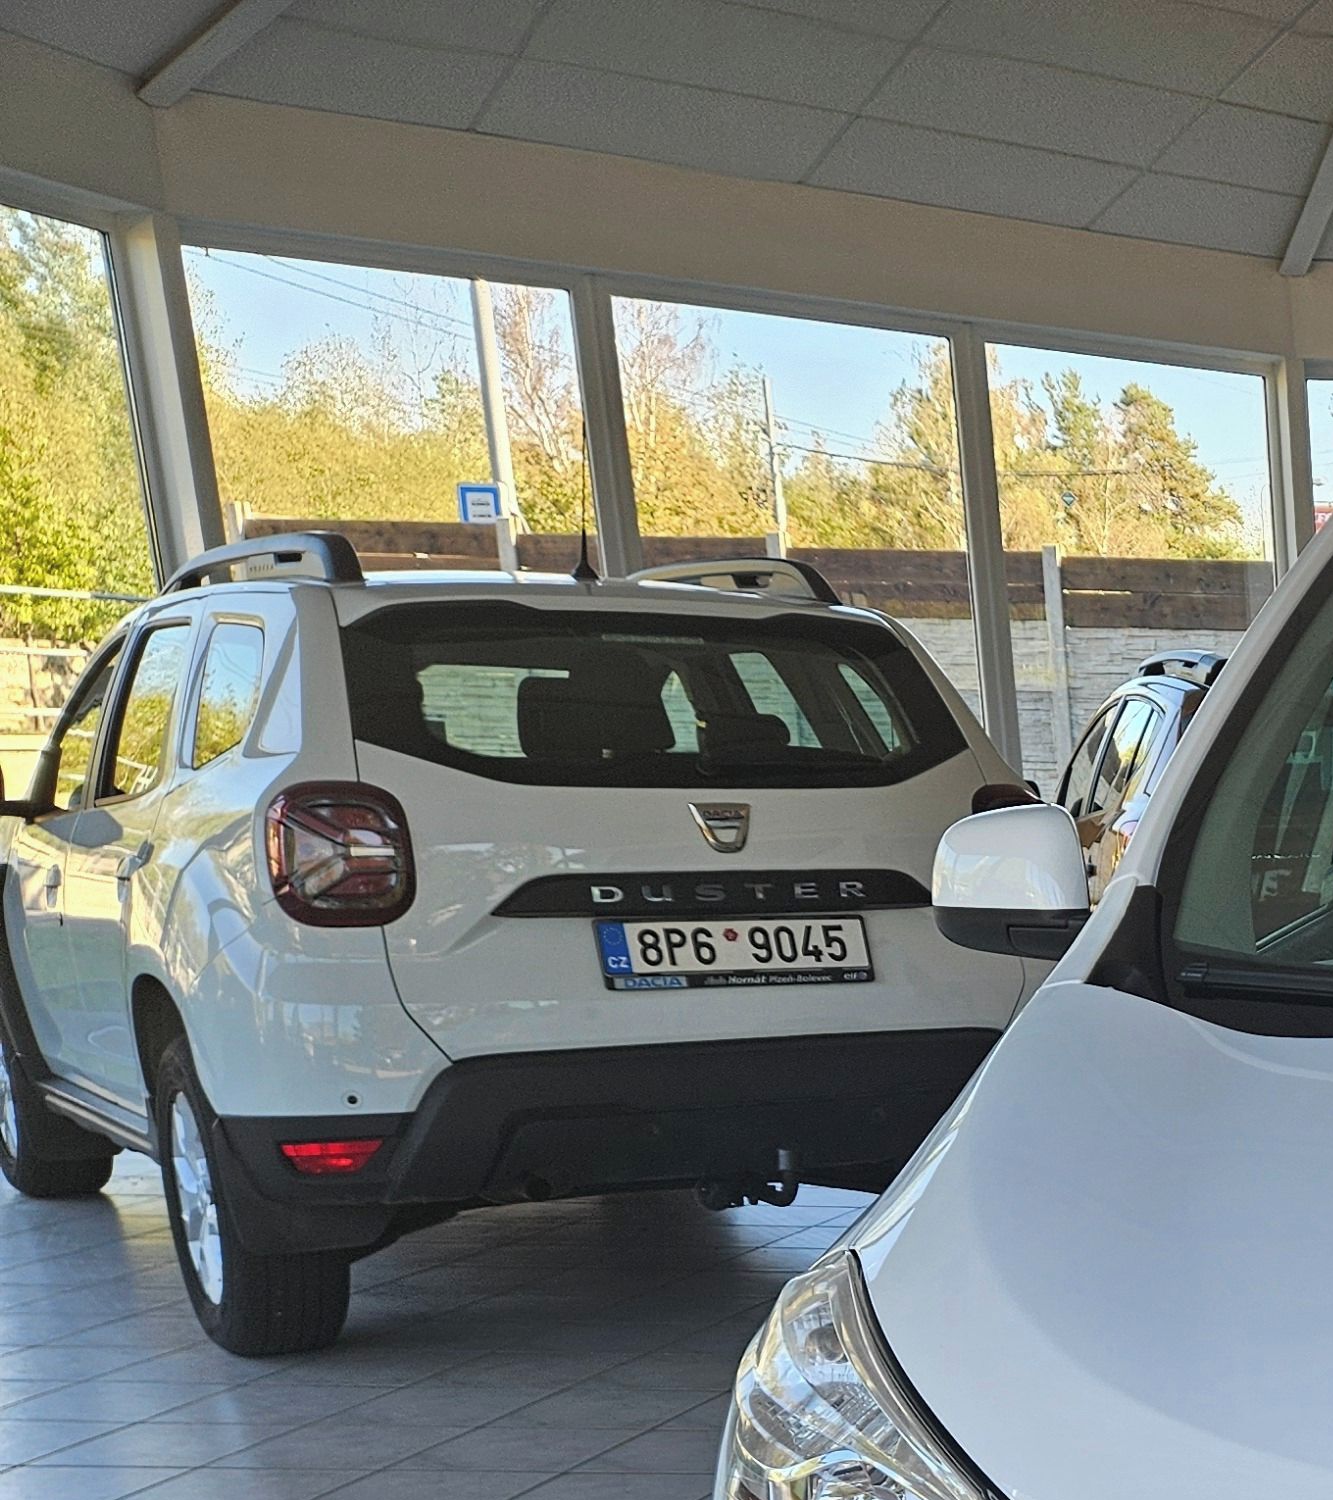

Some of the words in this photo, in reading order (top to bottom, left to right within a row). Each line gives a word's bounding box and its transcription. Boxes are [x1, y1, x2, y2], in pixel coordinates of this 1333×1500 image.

[591, 882, 866, 902] DUSTER
[637, 926, 717, 967] 8P6
[748, 925, 848, 964] 9045
[607, 956, 630, 969] CZ
[624, 976, 682, 988] DACIA
